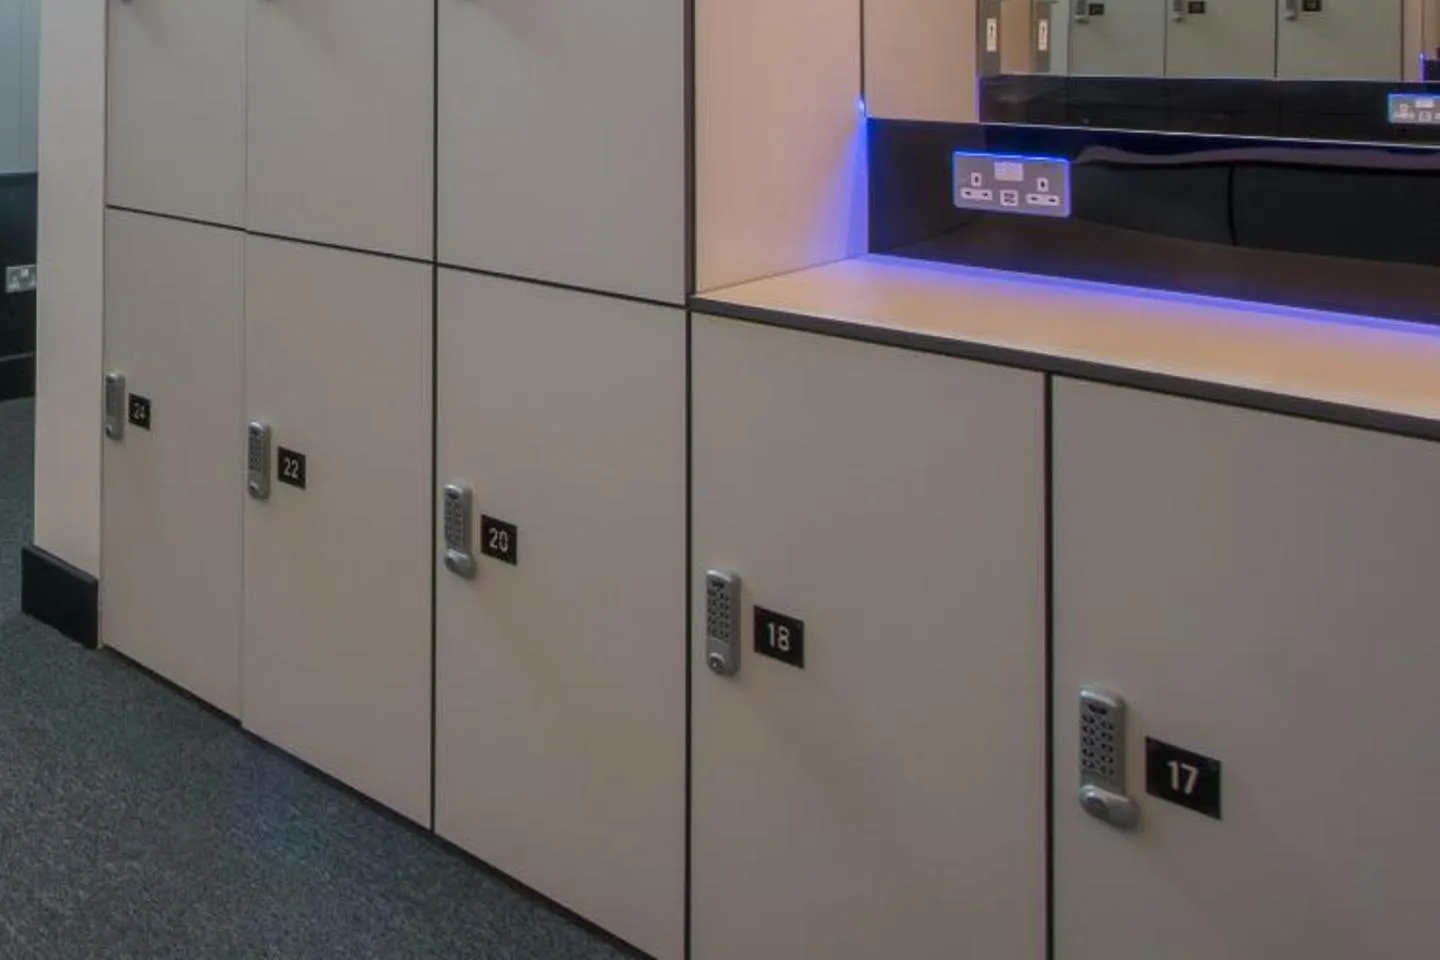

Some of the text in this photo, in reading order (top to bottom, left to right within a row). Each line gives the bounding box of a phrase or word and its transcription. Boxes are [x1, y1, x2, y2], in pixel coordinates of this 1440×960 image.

[283, 456, 299, 480] 22
[489, 527, 509, 553] 20
[767, 622, 790, 652] 18
[1167, 760, 1199, 795] 17
